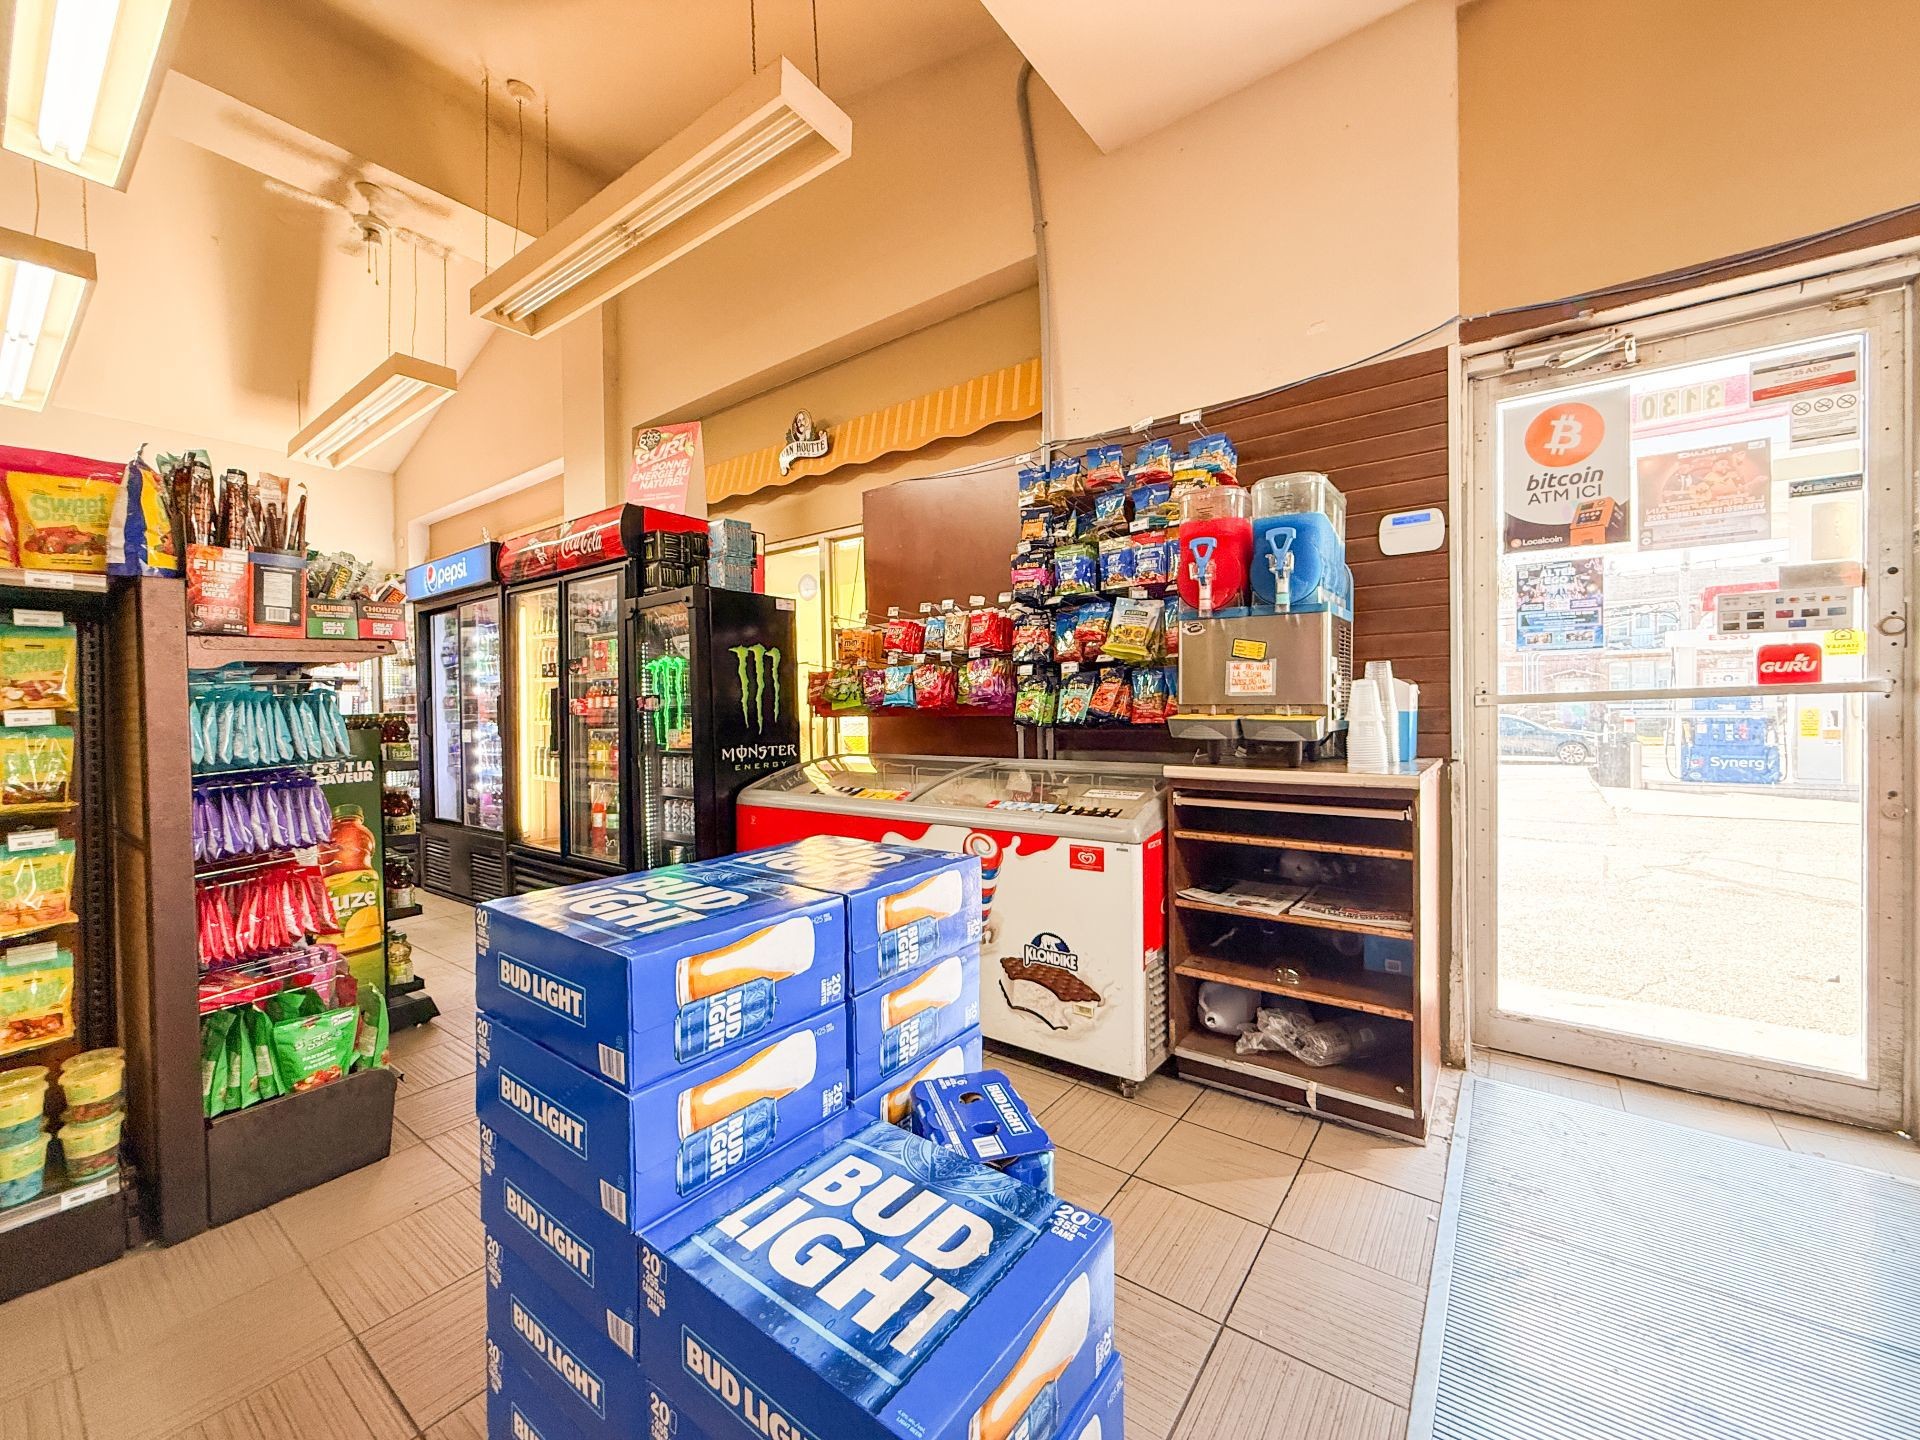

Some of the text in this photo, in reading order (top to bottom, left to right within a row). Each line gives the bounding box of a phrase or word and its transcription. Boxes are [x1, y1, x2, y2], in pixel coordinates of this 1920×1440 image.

[797, 440, 826, 453] HOUTTE
[652, 458, 688, 471] BONNE
[676, 467, 690, 477] AU
[640, 475, 684, 490] NATUREL
[1526, 466, 1604, 492] bitcoin
[1528, 483, 1601, 506] ATM ICI
[30, 494, 107, 521] Sweet
[1522, 536, 1563, 546] Localcoin
[193, 559, 245, 574] FIRE
[437, 557, 468, 589] pepsi
[310, 604, 354, 613] CHUBBER
[362, 605, 403, 615] CHORIZO
[1760, 658, 1818, 673] GURU
[722, 744, 797, 762] MONSTER
[735, 760, 788, 771] ENERGY
[1710, 756, 1776, 771] Synergy
[315, 771, 374, 786] SAVEUR
[356, 760, 375, 772] LA
[328, 890, 377, 911] uze
[614, 876, 750, 910] BUD
[476, 908, 488, 926] 20
[898, 926, 909, 972] LIGHT
[908, 925, 919, 964] BUD
[1024, 945, 1078, 971] KLONDIKE
[500, 959, 583, 1019] BUD LIGHT
[831, 973, 842, 994] 20
[708, 992, 727, 1052] LIGHT
[725, 990, 743, 1039] BUD
[476, 1019, 488, 1038] 20
[909, 1018, 920, 1057] BUD
[899, 1020, 910, 1068] LIGHT
[501, 1074, 583, 1150] BUD LIGHT
[986, 1084, 1029, 1133] BUD LIGHT
[481, 1124, 493, 1145] 20
[726, 1114, 745, 1165] BUD
[709, 1120, 728, 1180] LIGHT
[799, 1154, 994, 1270] BUD
[1055, 1204, 1091, 1226] 20
[506, 1185, 539, 1231] BUD
[540, 1214, 591, 1276] LIGHT
[1050, 1225, 1076, 1242] CANS
[486, 1235, 499, 1259] 20
[641, 1246, 660, 1278] 20
[715, 1186, 970, 1356] LIGHT
[487, 1338, 499, 1363] 20
[513, 1303, 601, 1406] BUD LIGHT
[686, 1336, 809, 1440] BUD LIG
[650, 1391, 670, 1424] 20
